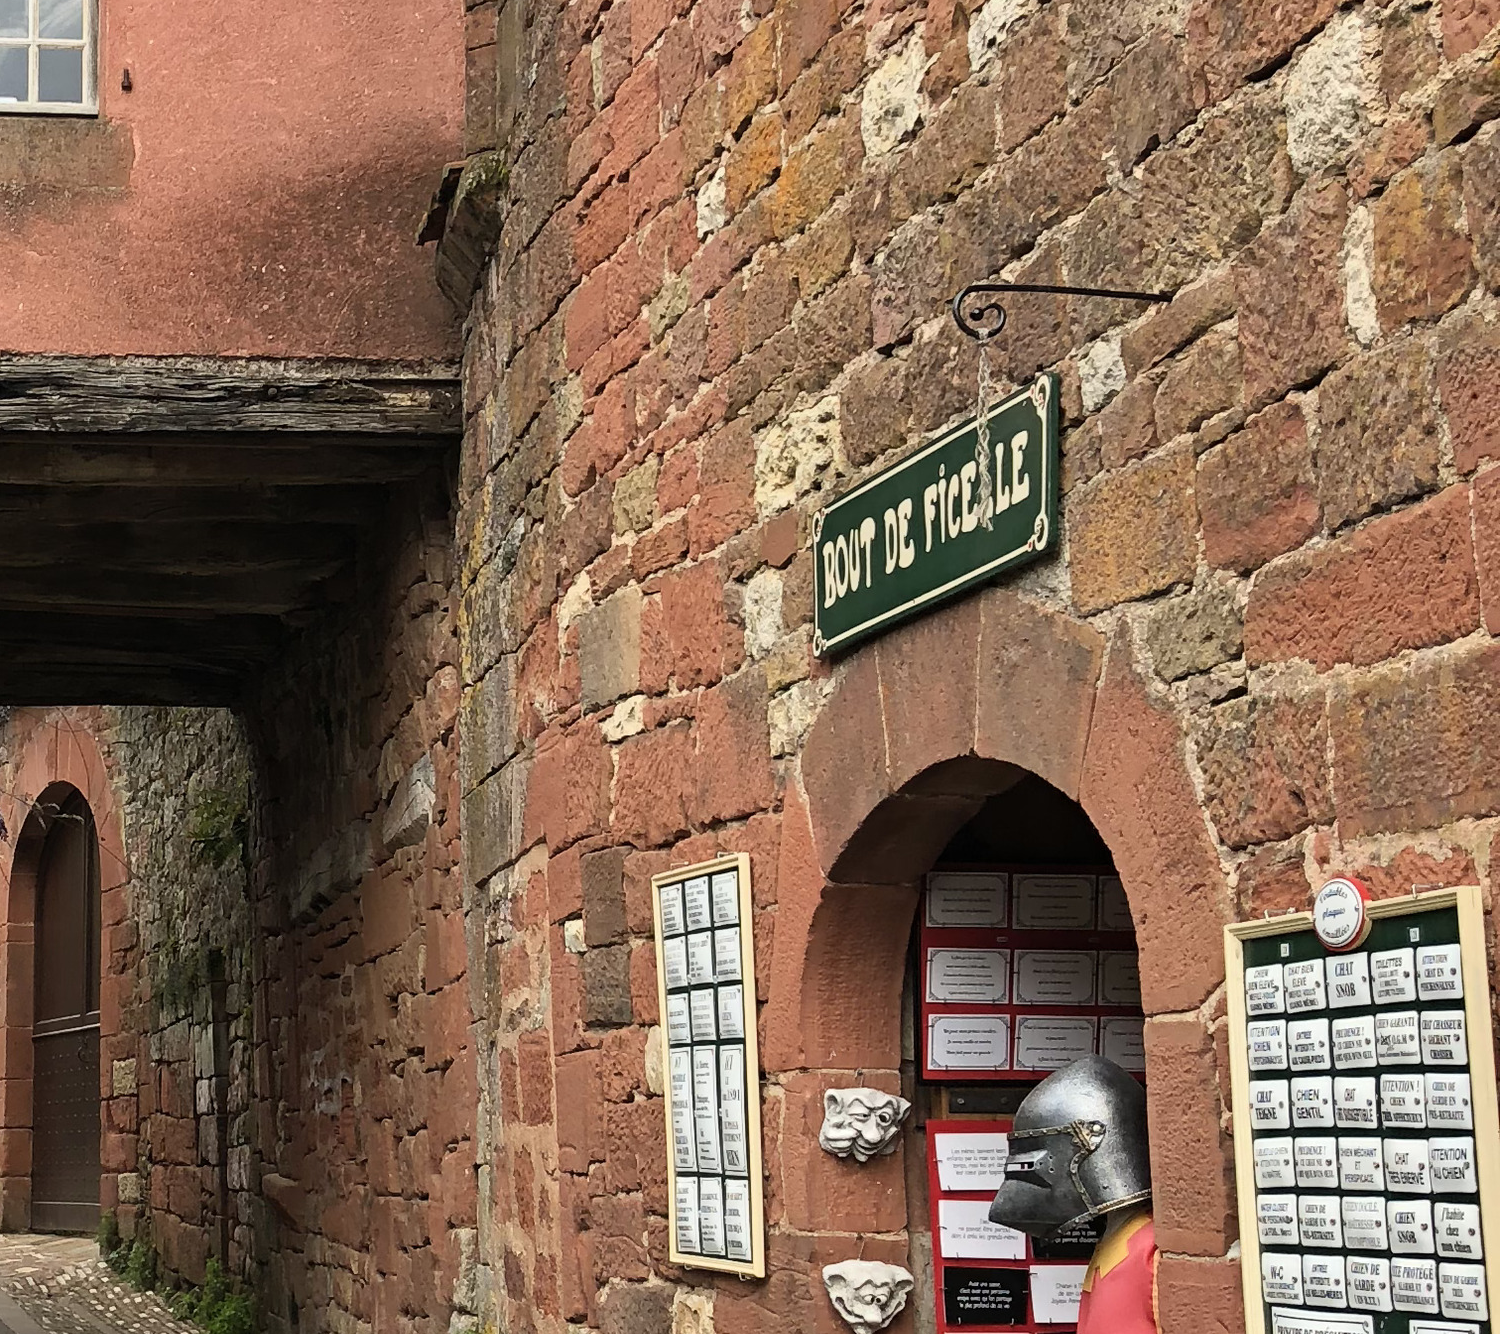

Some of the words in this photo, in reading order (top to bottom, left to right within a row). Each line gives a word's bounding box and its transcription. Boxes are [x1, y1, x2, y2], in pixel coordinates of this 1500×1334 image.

[822, 517, 876, 609] BOUT
[884, 497, 914, 575] DE
[924, 430, 1029, 553] FICELE
[1335, 961, 1354, 977] CHAT
[1335, 982, 1356, 998] SNOB
[1390, 1017, 1415, 1028] GARANTI
[1433, 1019, 1462, 1030] CHASSEUR
[1256, 1090, 1272, 1103] CHAT
[1296, 1089, 1319, 1101] CHIEN
[1296, 1107, 1324, 1119] GENTIL
[1395, 1153, 1409, 1165] CHAT
[1431, 1148, 1467, 1160] ATTENTION
[1442, 1167, 1465, 1179] CHIEN
[1395, 1212, 1415, 1224] CHIEN
[1445, 1224, 1459, 1237] chez
[1370, 1263, 1380, 1276] DE
[1402, 1264, 1434, 1280] PROTÉGÉ
[1354, 1278, 1375, 1292] GARDE
